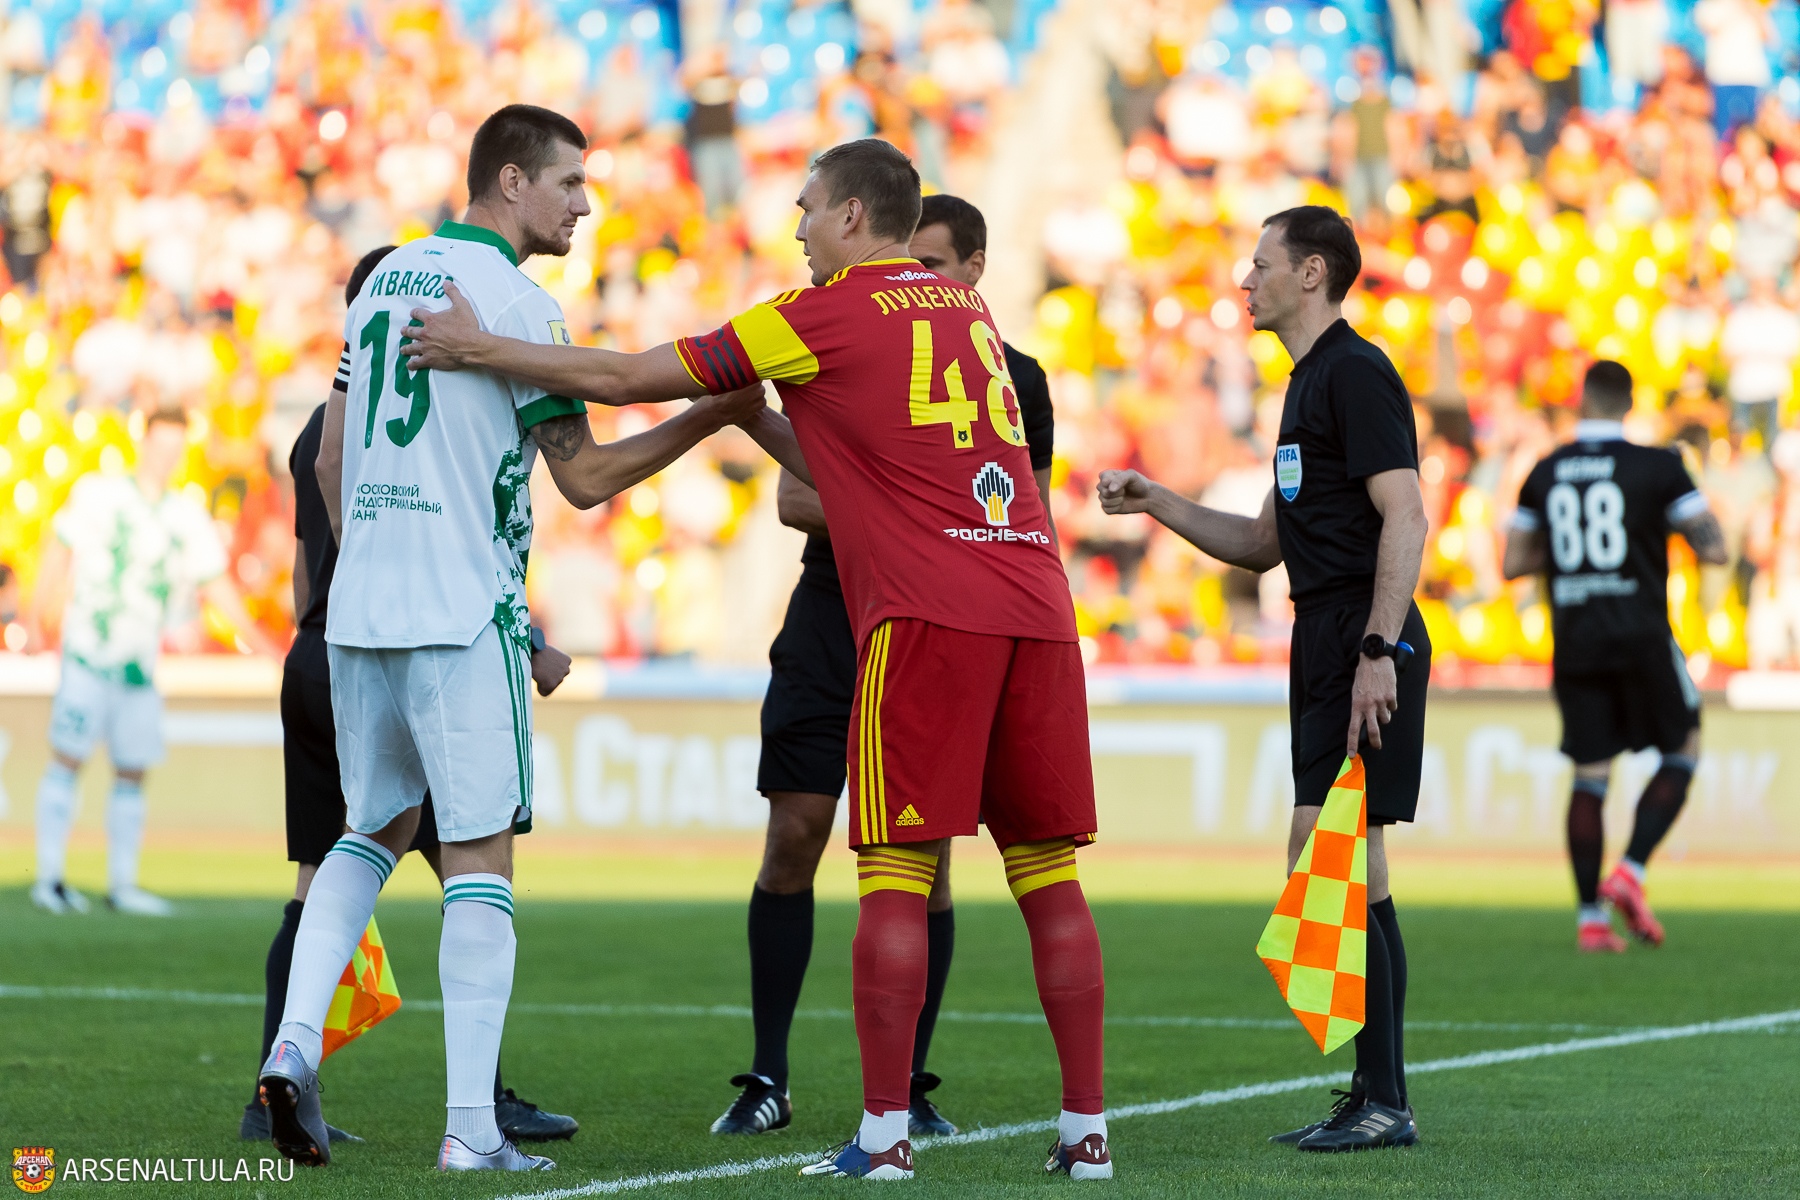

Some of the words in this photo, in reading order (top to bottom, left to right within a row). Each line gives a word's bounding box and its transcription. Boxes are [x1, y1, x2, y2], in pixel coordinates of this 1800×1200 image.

[870, 285, 984, 316] ЛУЦЕНКО
[360, 311, 431, 449] 19
[908, 319, 1027, 449] 48
[1278, 448, 1298, 462] FIFA
[357, 483, 419, 498] ОСКОВСКИЙ
[1546, 480, 1628, 573] 88
[895, 817, 925, 826] adidas
